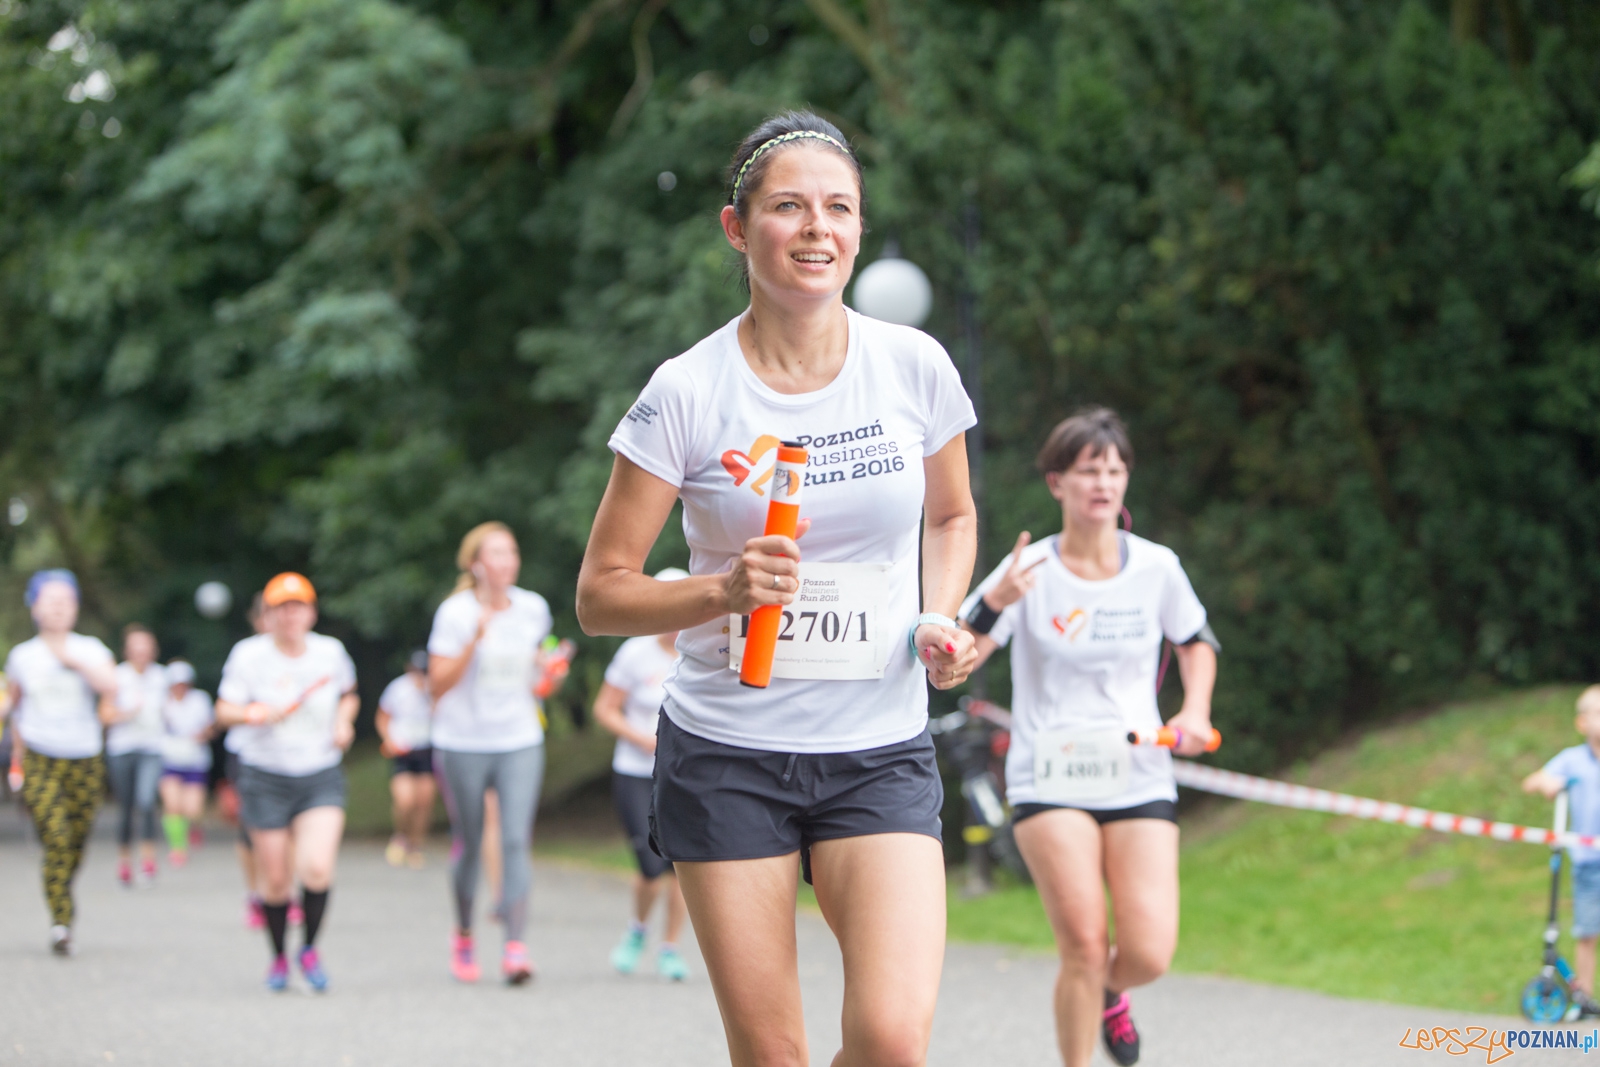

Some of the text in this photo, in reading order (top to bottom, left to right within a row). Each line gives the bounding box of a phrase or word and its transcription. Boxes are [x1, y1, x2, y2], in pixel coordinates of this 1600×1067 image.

[796, 419, 884, 448] Poznań
[852, 456, 905, 479] 2016
[803, 578, 836, 586] Poznań
[801, 586, 839, 594] Business
[800, 594, 840, 602] Run 2016
[778, 610, 870, 642] 270/1
